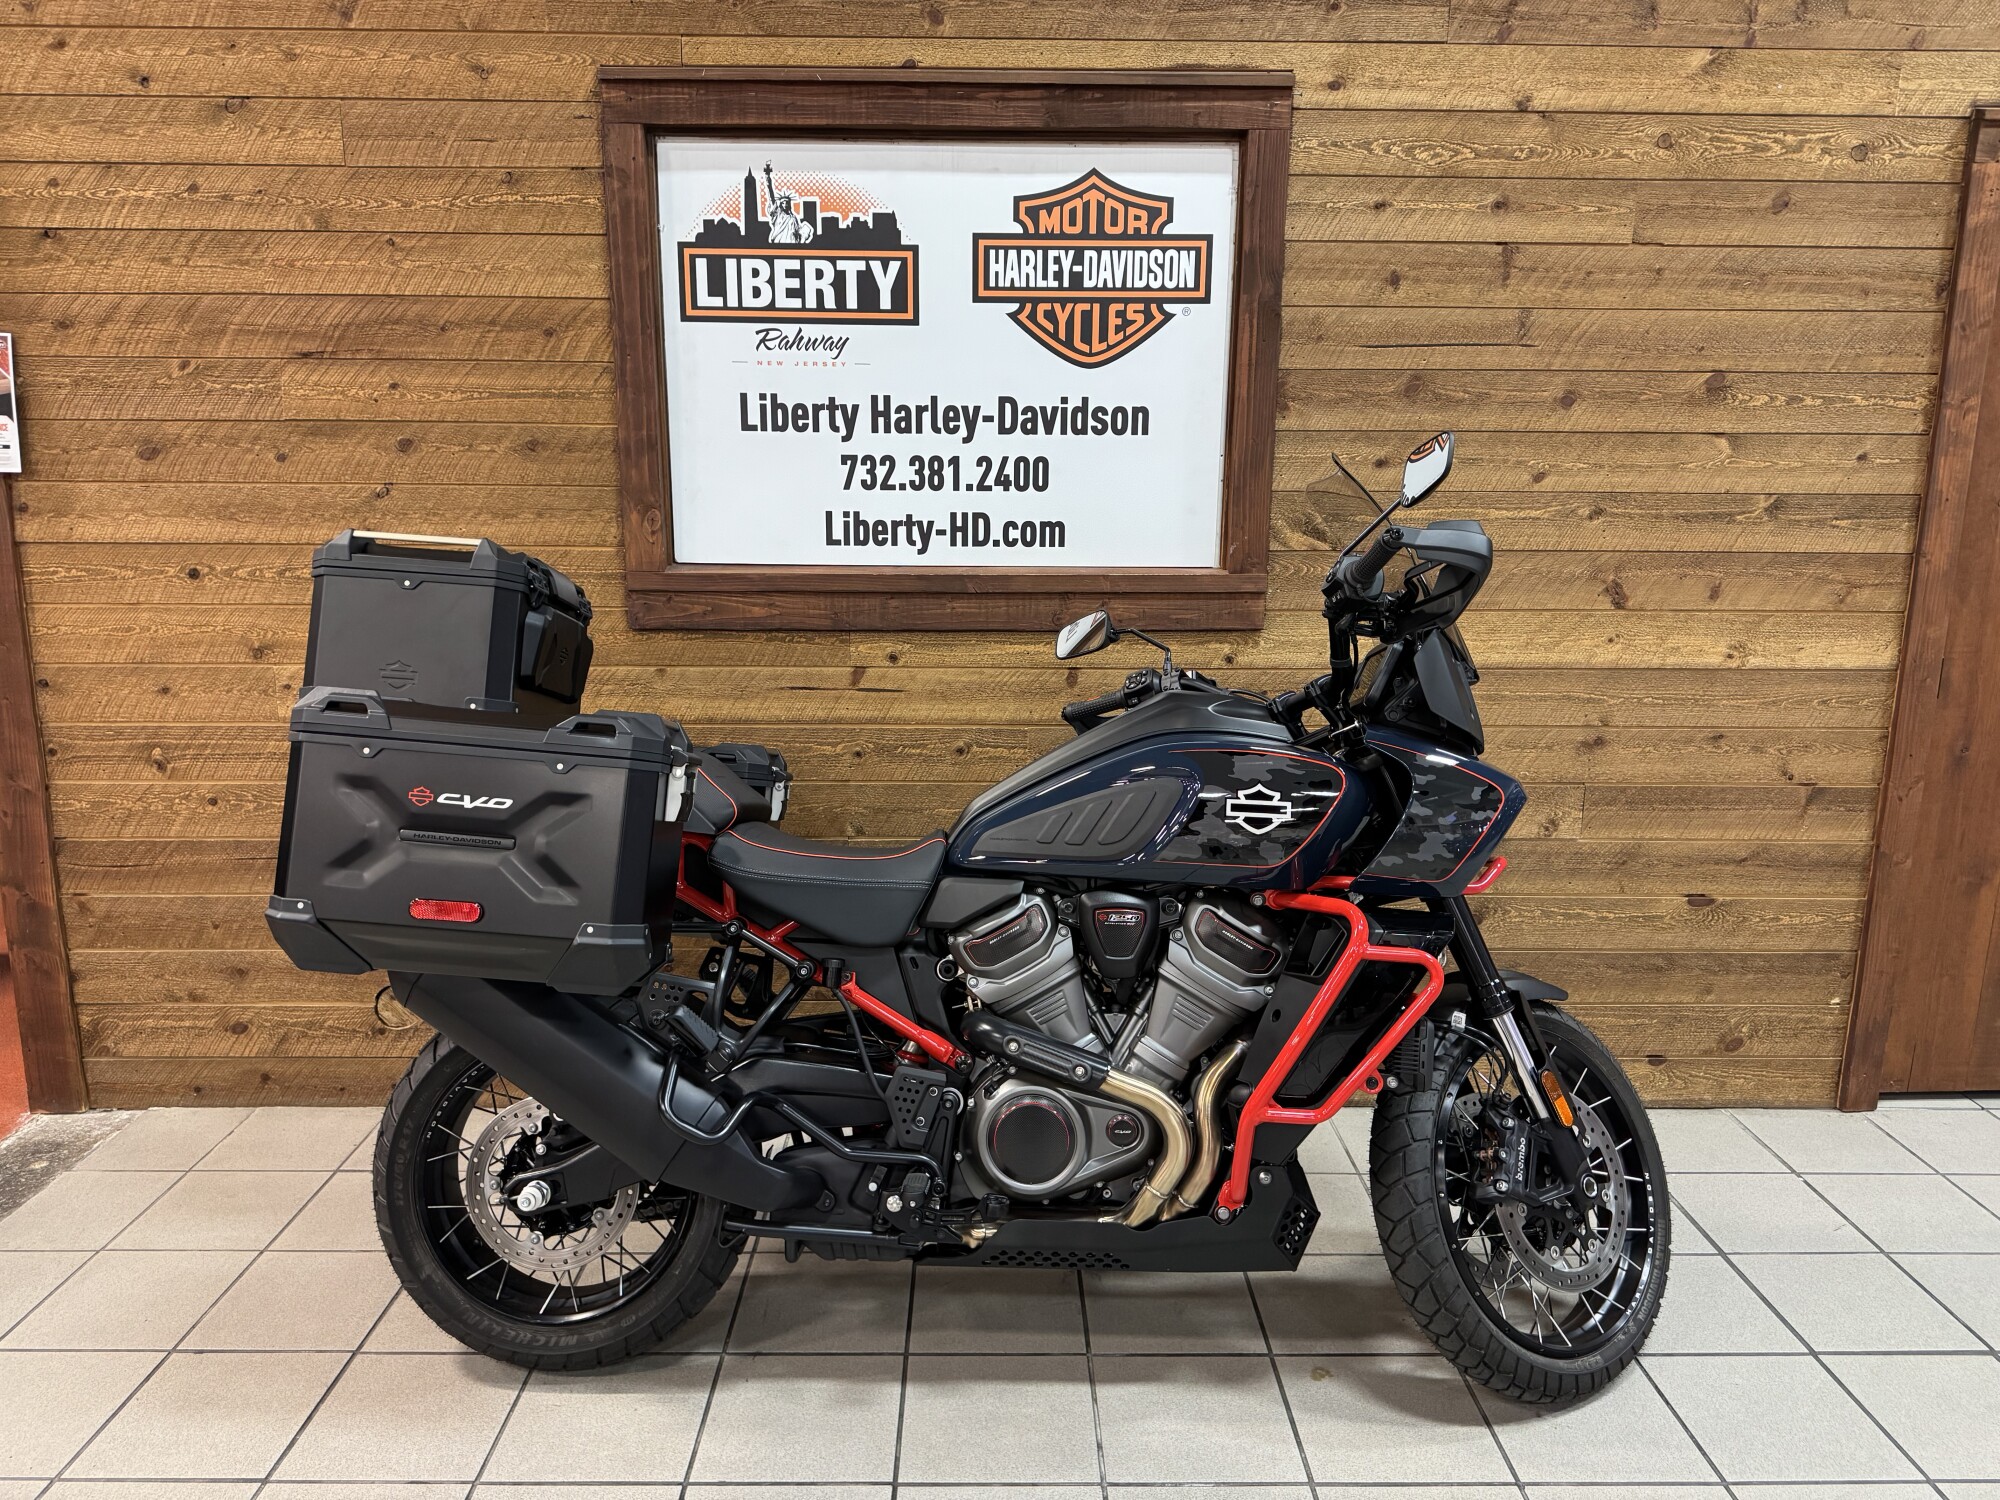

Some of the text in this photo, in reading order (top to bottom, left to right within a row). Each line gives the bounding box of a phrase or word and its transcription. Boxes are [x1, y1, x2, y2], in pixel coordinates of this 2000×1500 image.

[1038, 188, 1148, 234] MOTOR
[695, 257, 902, 310] LIBERTY
[989, 248, 1196, 289] HARLEY-DAVIDSON
[755, 326, 850, 360] Rahway
[1036, 302, 1145, 353] CYCLES
[739, 392, 1150, 444] Liberty Harley-Davidson
[840, 454, 1050, 493] 732.381.2400
[825, 510, 1066, 556] Liberty-HD.com
[436, 792, 514, 809] CVO
[413, 832, 502, 846] HARLEY-DAVIDSON
[1515, 1137, 1526, 1181] brembo
[462, 1309, 578, 1347] MICHELIN
